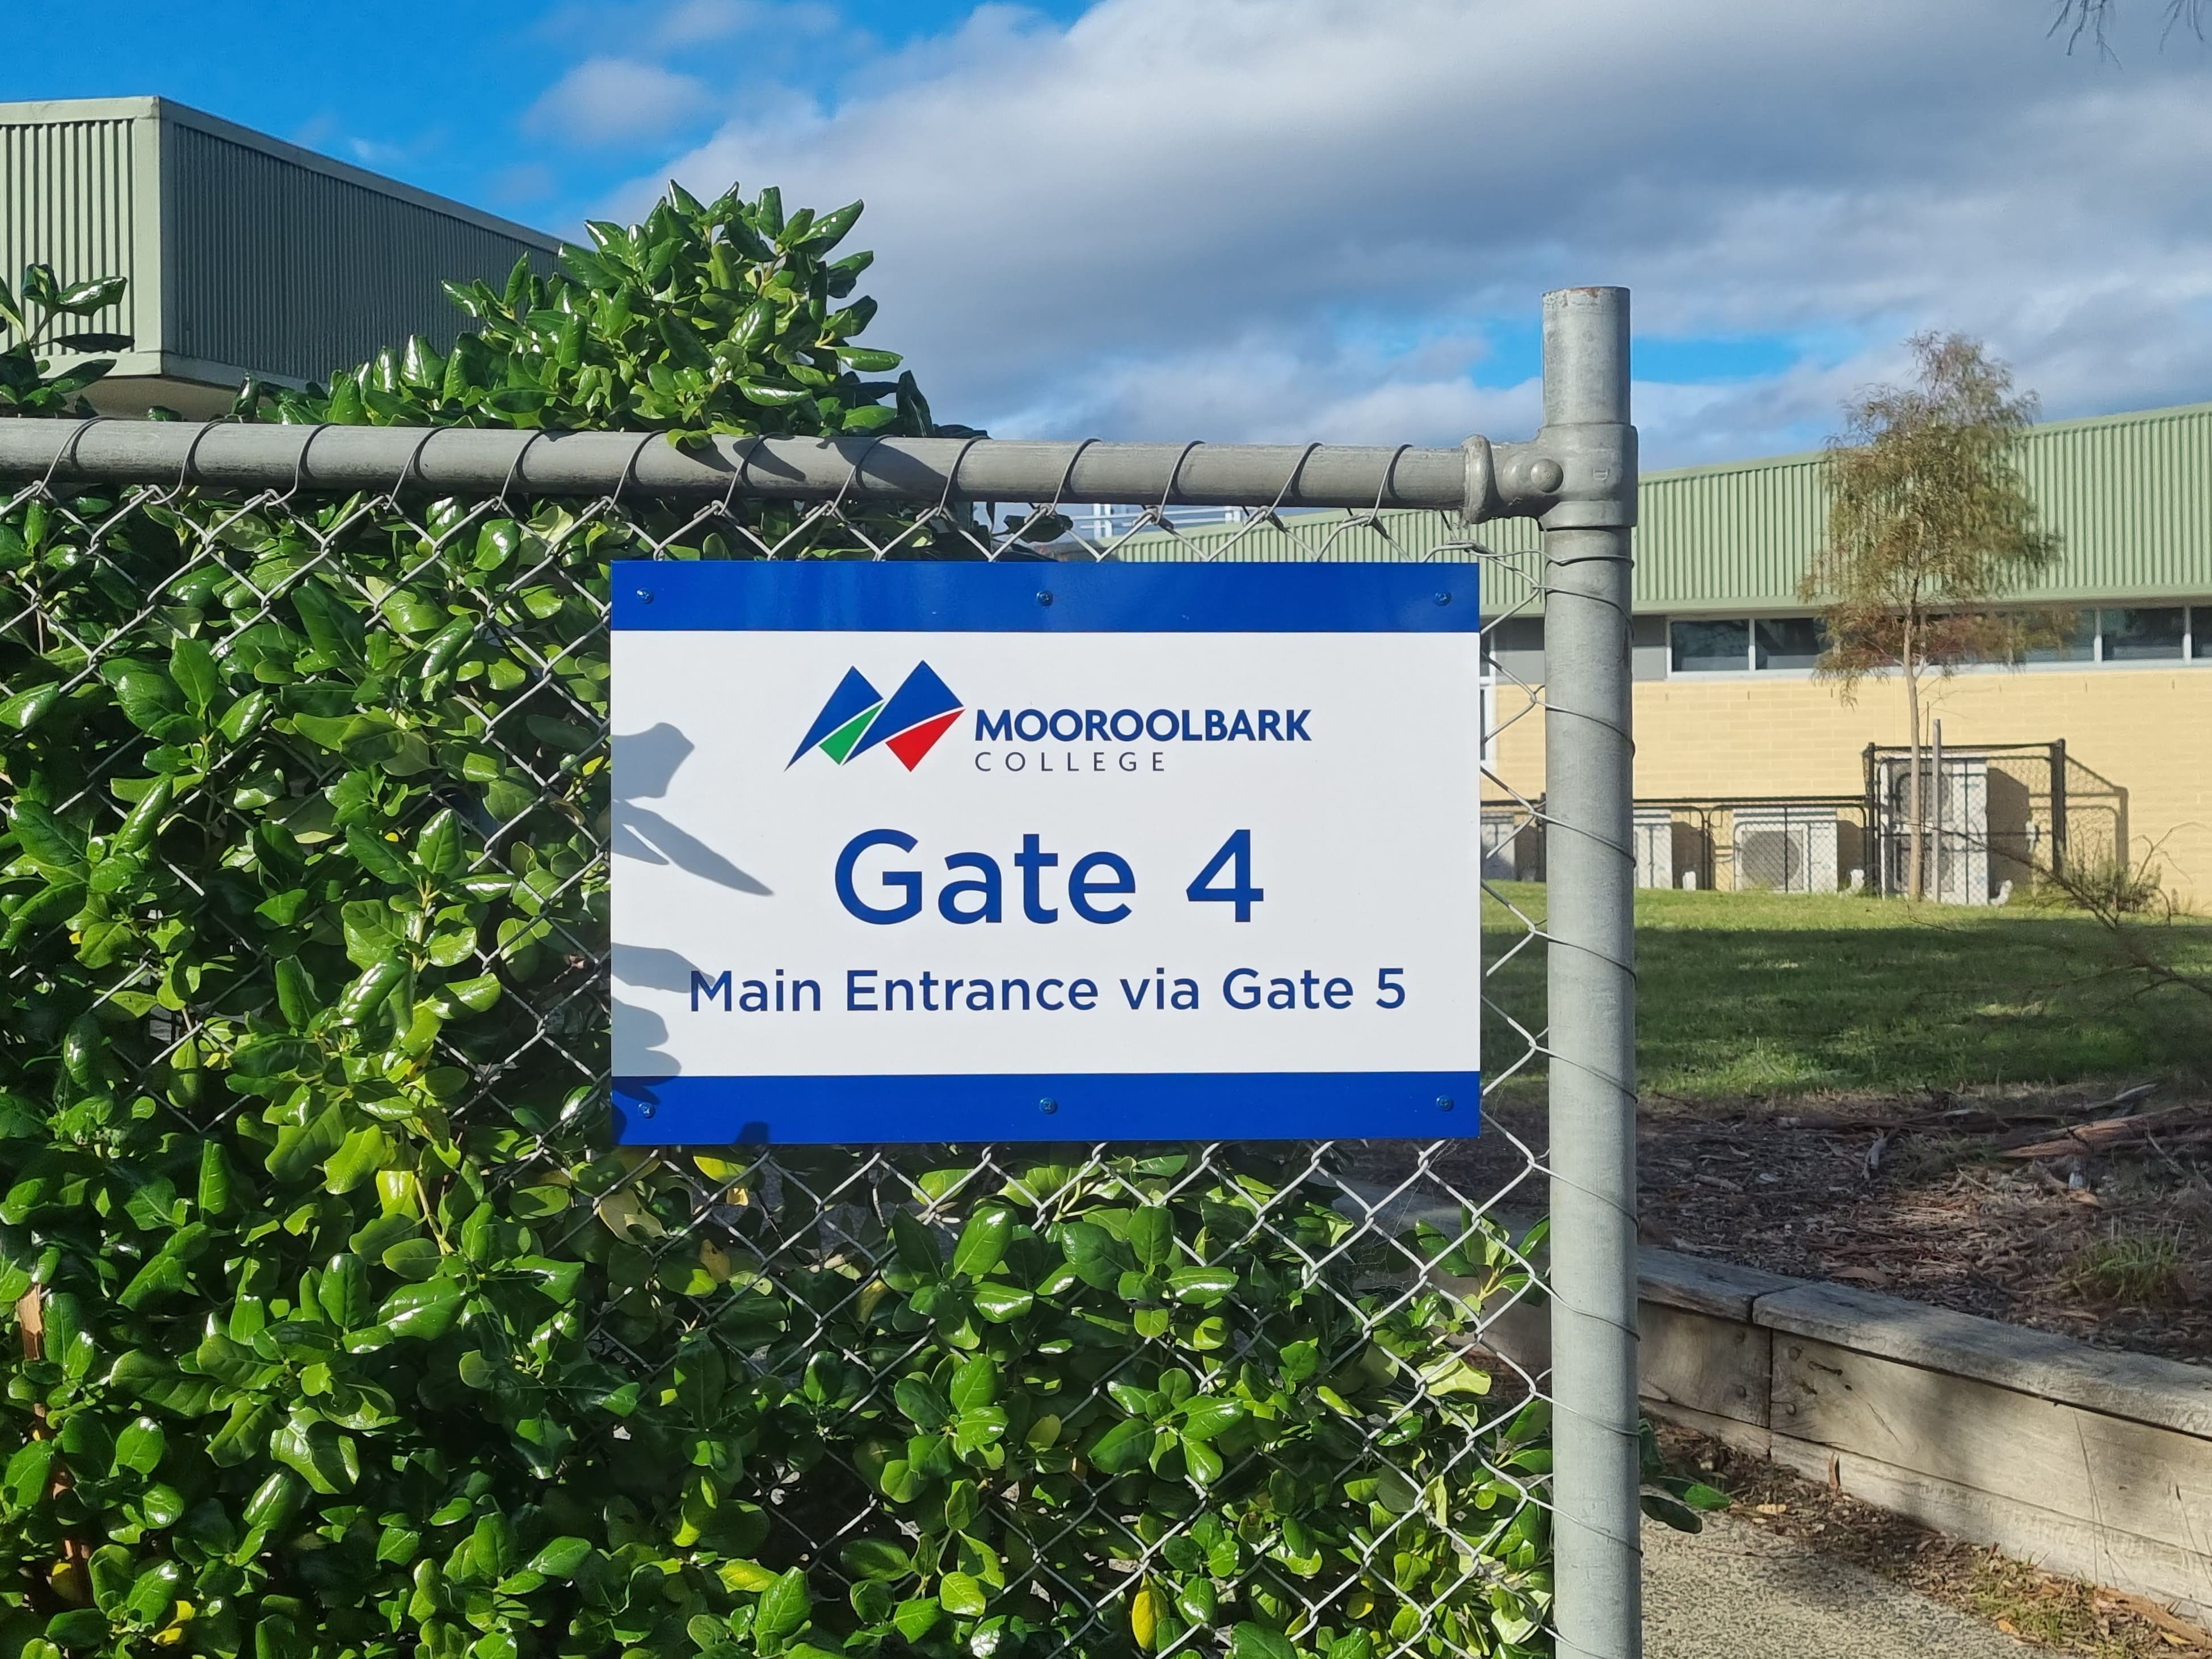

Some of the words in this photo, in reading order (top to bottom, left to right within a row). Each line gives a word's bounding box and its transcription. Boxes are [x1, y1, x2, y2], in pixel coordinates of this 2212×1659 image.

[975, 709, 1312, 742] MOOROOLBARK
[974, 751, 1165, 772] COLLEGE
[835, 828, 1136, 925] Gate
[1185, 829, 1264, 923] 4
[691, 969, 821, 1012] Main
[847, 970, 1099, 1011] Entrance
[1120, 967, 1199, 1010] via
[1222, 967, 1354, 1010] Gate
[1376, 967, 1406, 1010] 5
